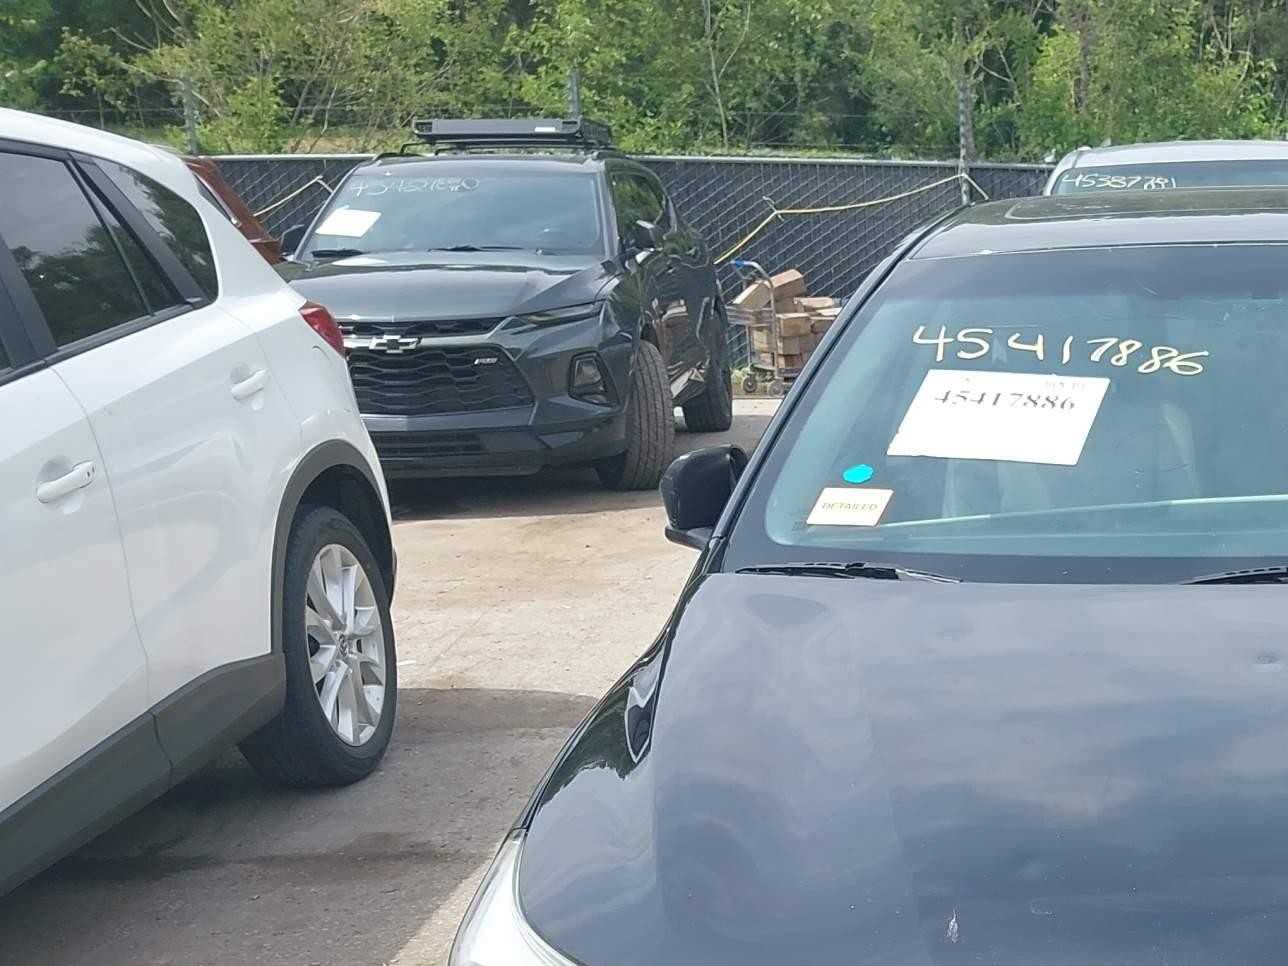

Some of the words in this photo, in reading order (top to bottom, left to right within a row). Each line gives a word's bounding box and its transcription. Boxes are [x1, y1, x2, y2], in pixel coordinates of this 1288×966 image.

[912, 324, 1209, 375] 45417886
[935, 389, 1076, 410] 45417886
[821, 502, 879, 511] DETAILED
